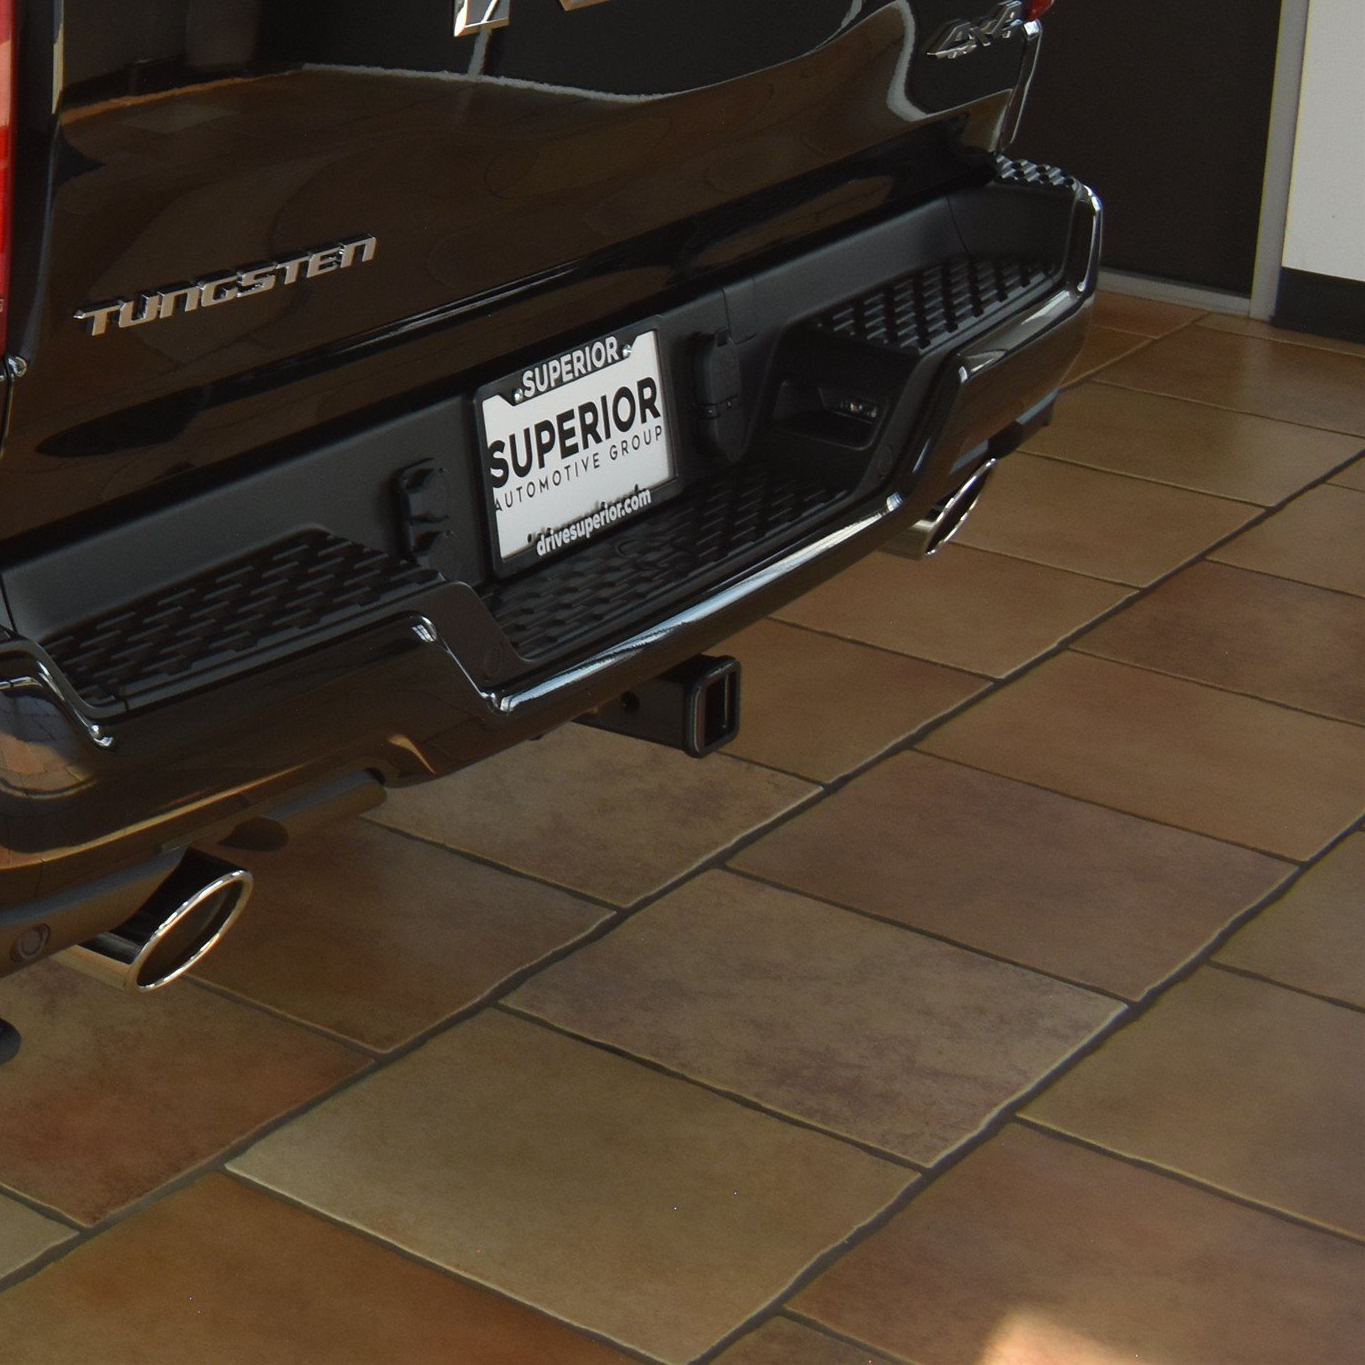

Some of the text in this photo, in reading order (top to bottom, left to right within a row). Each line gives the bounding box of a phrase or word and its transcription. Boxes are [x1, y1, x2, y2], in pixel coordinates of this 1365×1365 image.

[73, 235, 377, 336] TUNGSTEN
[522, 336, 619, 398] SUPERIOR
[488, 377, 661, 489] SUPERIOR
[495, 425, 662, 512] AUTOMOTIVE GROUP
[536, 487, 652, 557] drivesuperior.com
